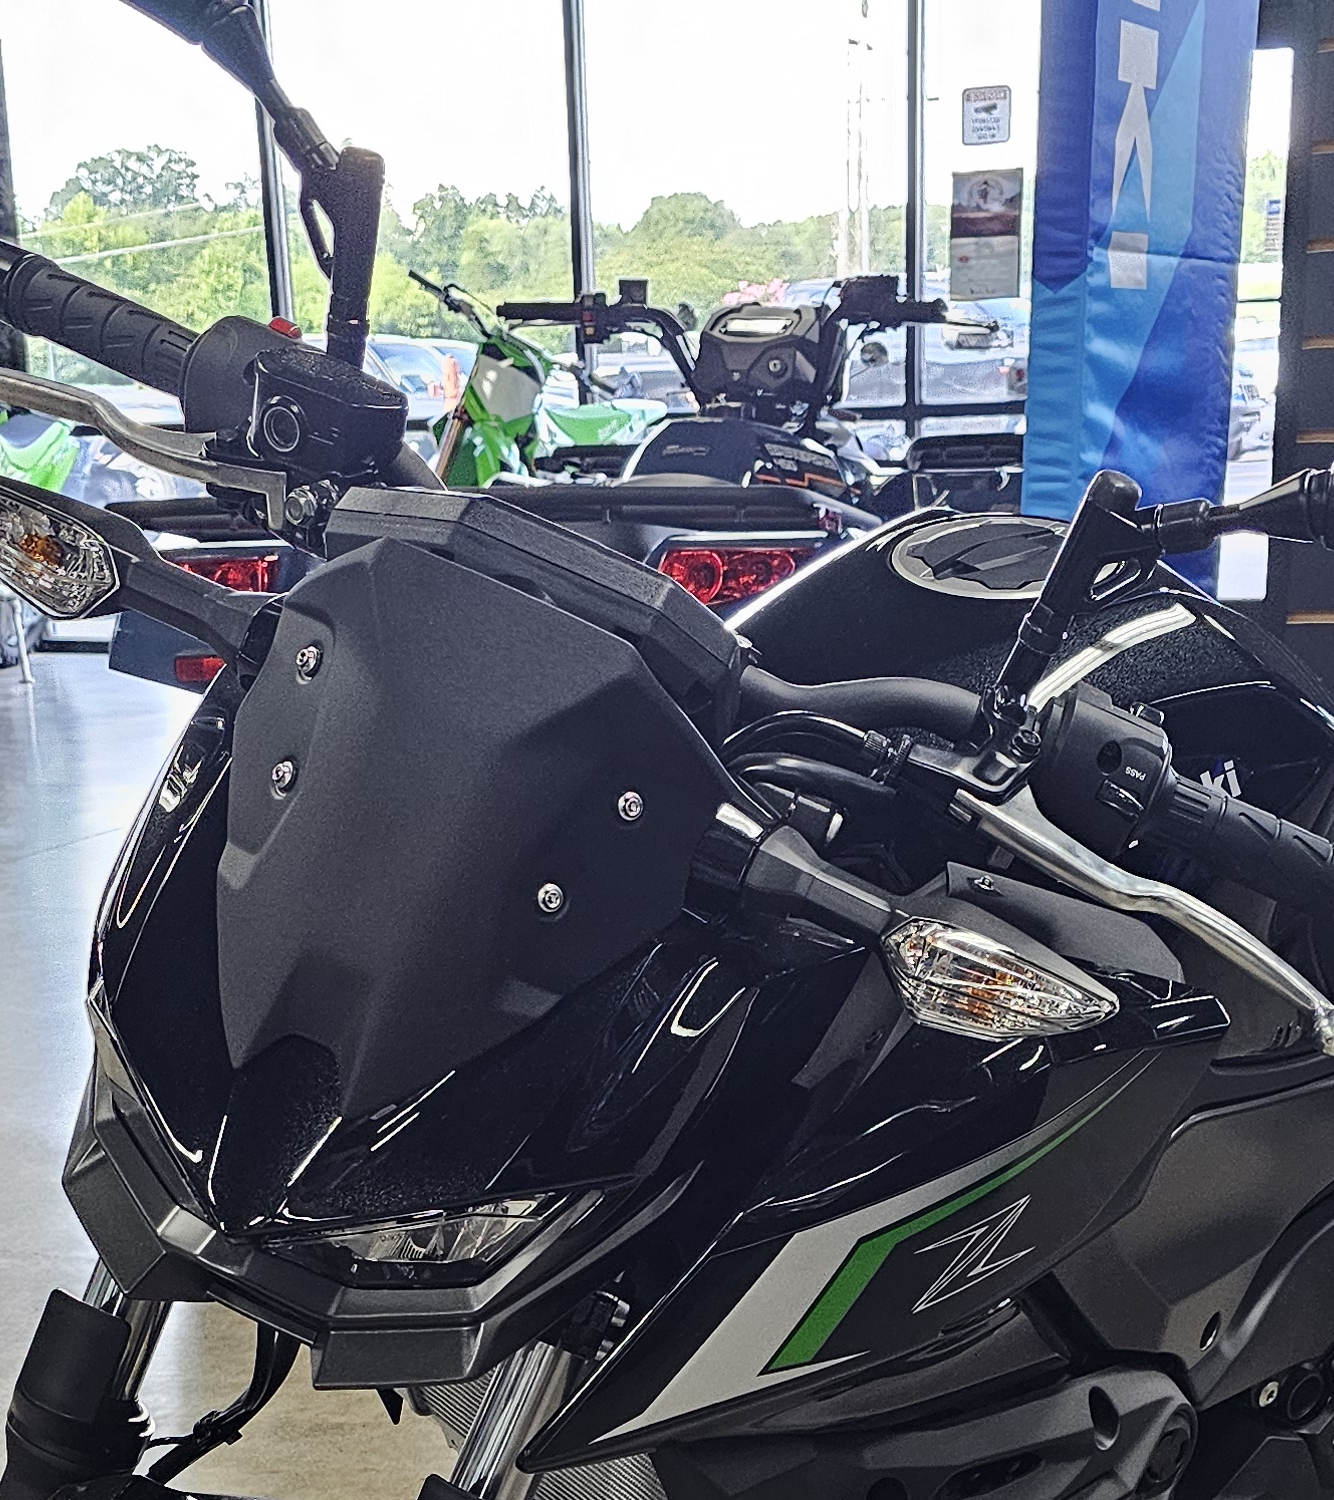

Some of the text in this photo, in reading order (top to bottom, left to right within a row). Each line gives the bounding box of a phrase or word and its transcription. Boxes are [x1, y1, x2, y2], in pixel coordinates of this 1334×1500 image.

[1125, 766, 1147, 781] PASS
[1200, 760, 1242, 797] ki
[911, 1194, 1036, 1314] Z
